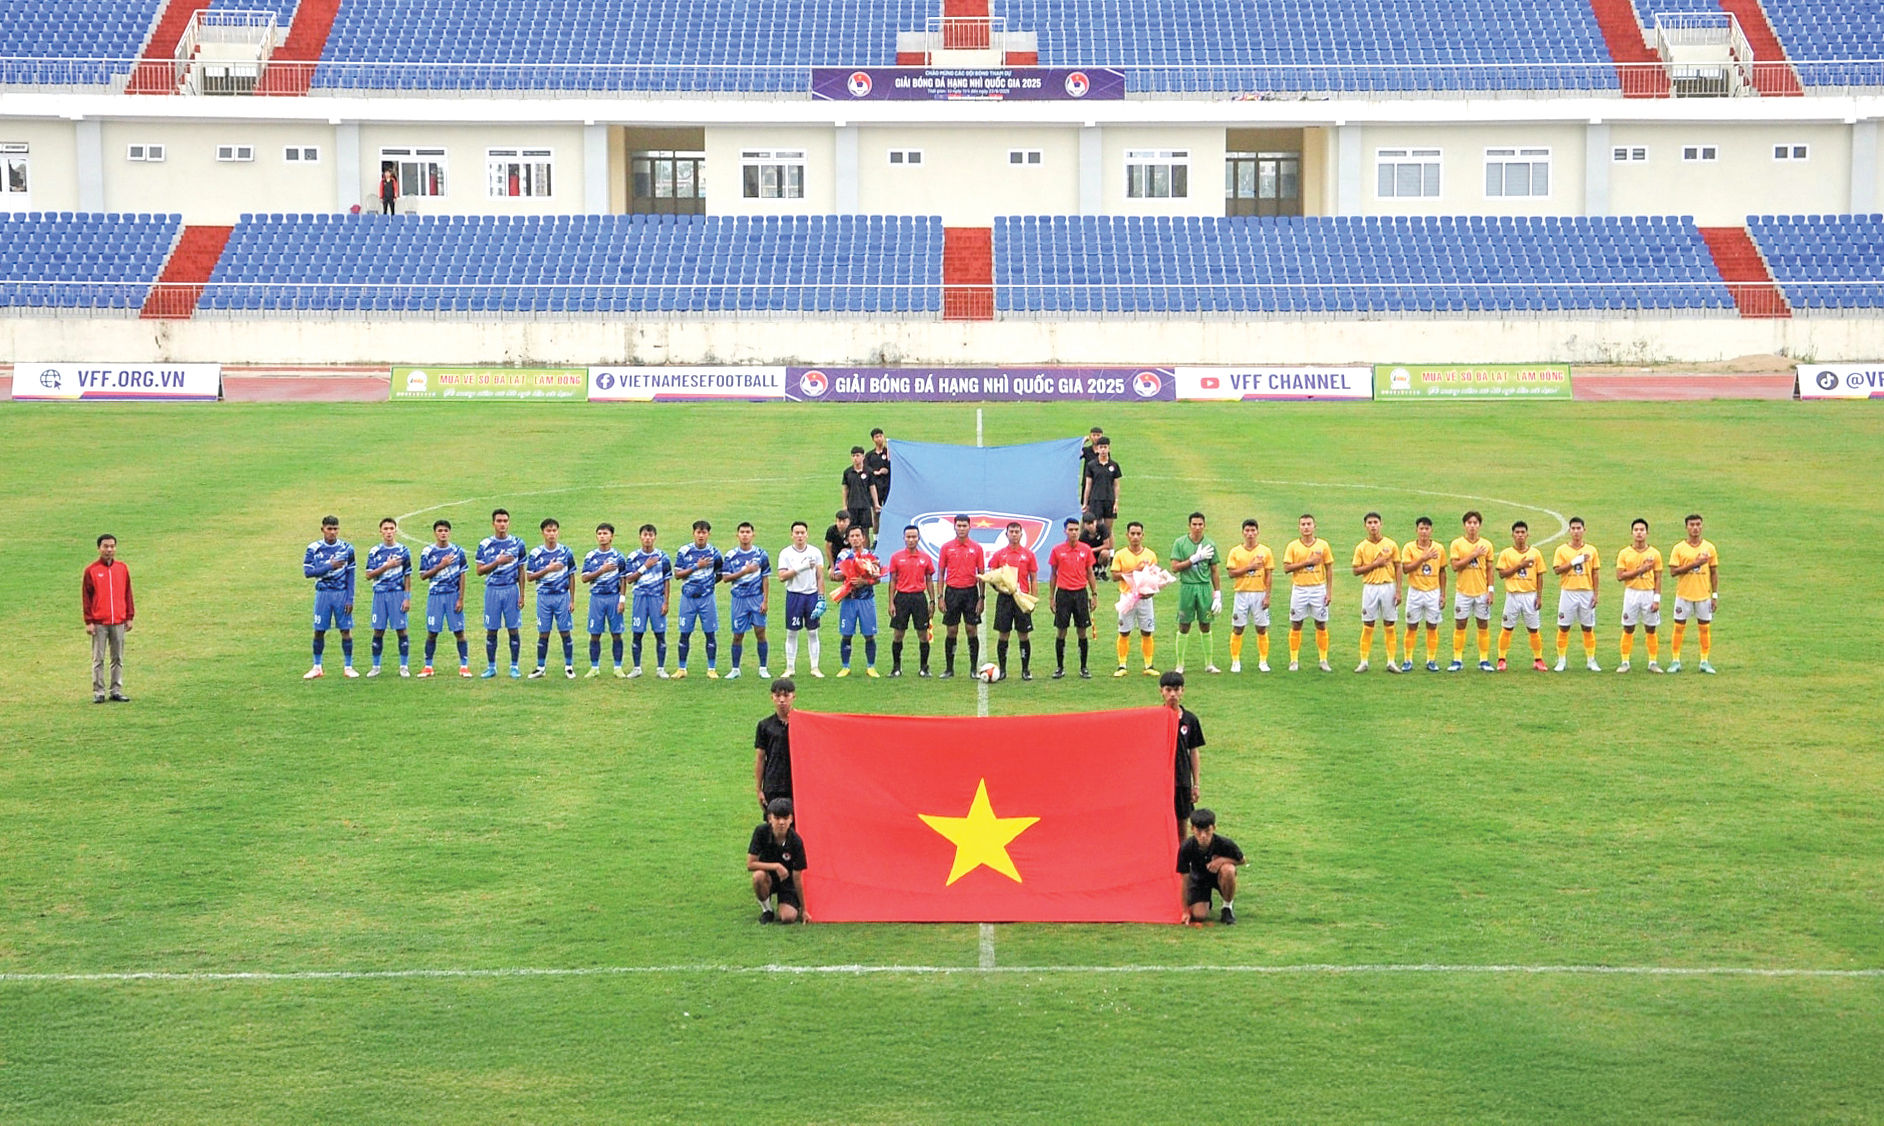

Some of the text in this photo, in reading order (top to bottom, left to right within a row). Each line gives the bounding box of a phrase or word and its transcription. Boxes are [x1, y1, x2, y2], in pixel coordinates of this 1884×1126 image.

[895, 76, 911, 88] GIẢI
[912, 76, 933, 88] BÓNG
[947, 78, 968, 90] HẠNG
[969, 76, 983, 88] NHÌ
[985, 76, 1006, 89] QUỐC
[1007, 78, 1021, 88] GIA
[1022, 78, 1042, 88] 2025
[78, 370, 185, 387] VFF.ORG.VN
[619, 375, 779, 387] VIETNAMESEFOOTBALL
[1230, 374, 1351, 390] VFF CHANNEL
[1422, 372, 1442, 381] MUA
[835, 373, 1125, 396] GIẢI BÓNG ĐÁ HẠNG NHÌ QUỐC GIA 2025
[792, 616, 800, 626] 24
